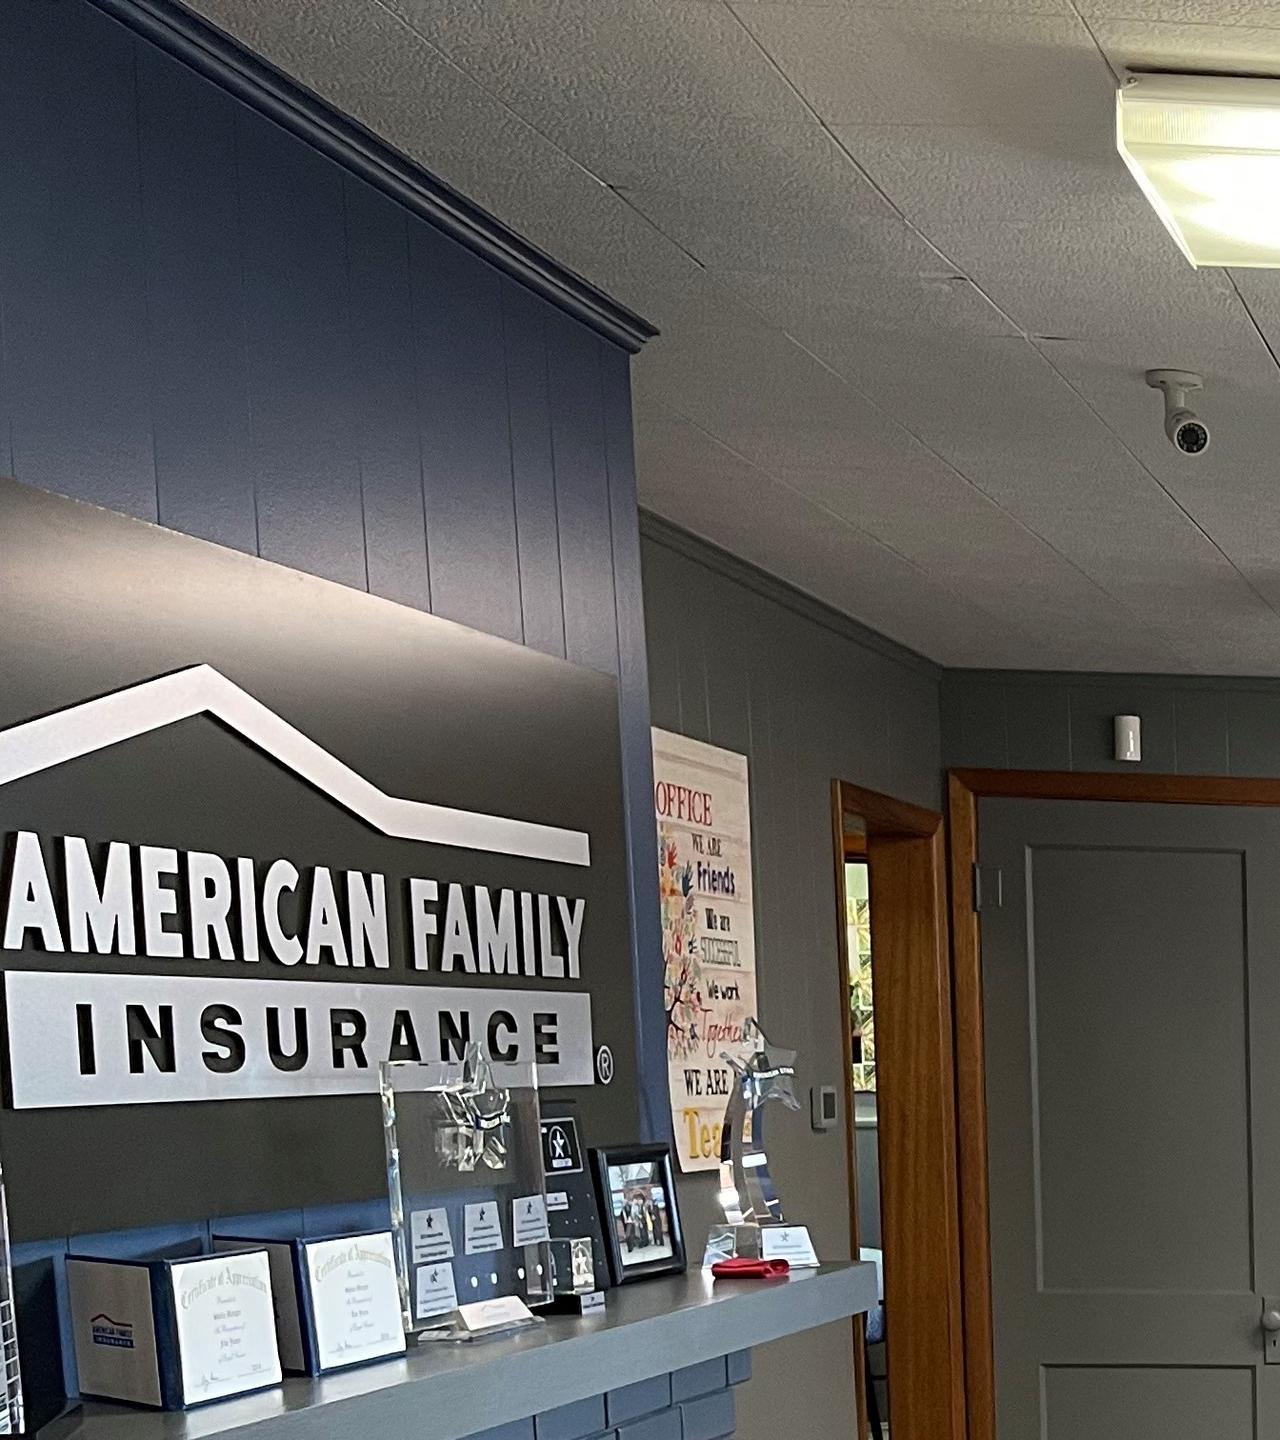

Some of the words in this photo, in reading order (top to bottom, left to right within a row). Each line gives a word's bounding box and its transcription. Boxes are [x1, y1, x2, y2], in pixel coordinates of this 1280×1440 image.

[656, 781, 712, 826] OFFICE
[691, 833, 704, 853] WE
[707, 839, 722, 857] ARE
[697, 861, 735, 896] Friends
[3, 831, 390, 968] AMERICAN
[409, 878, 585, 979] FAMILY
[705, 908, 717, 929] We
[720, 915, 731, 931] are
[707, 980, 719, 999] We
[720, 981, 740, 1001] work
[75, 1003, 561, 1076] INSURANCE
[700, 1008, 743, 1058] Togethe
[684, 1069, 702, 1096] WE
[706, 1070, 728, 1095] ARE
